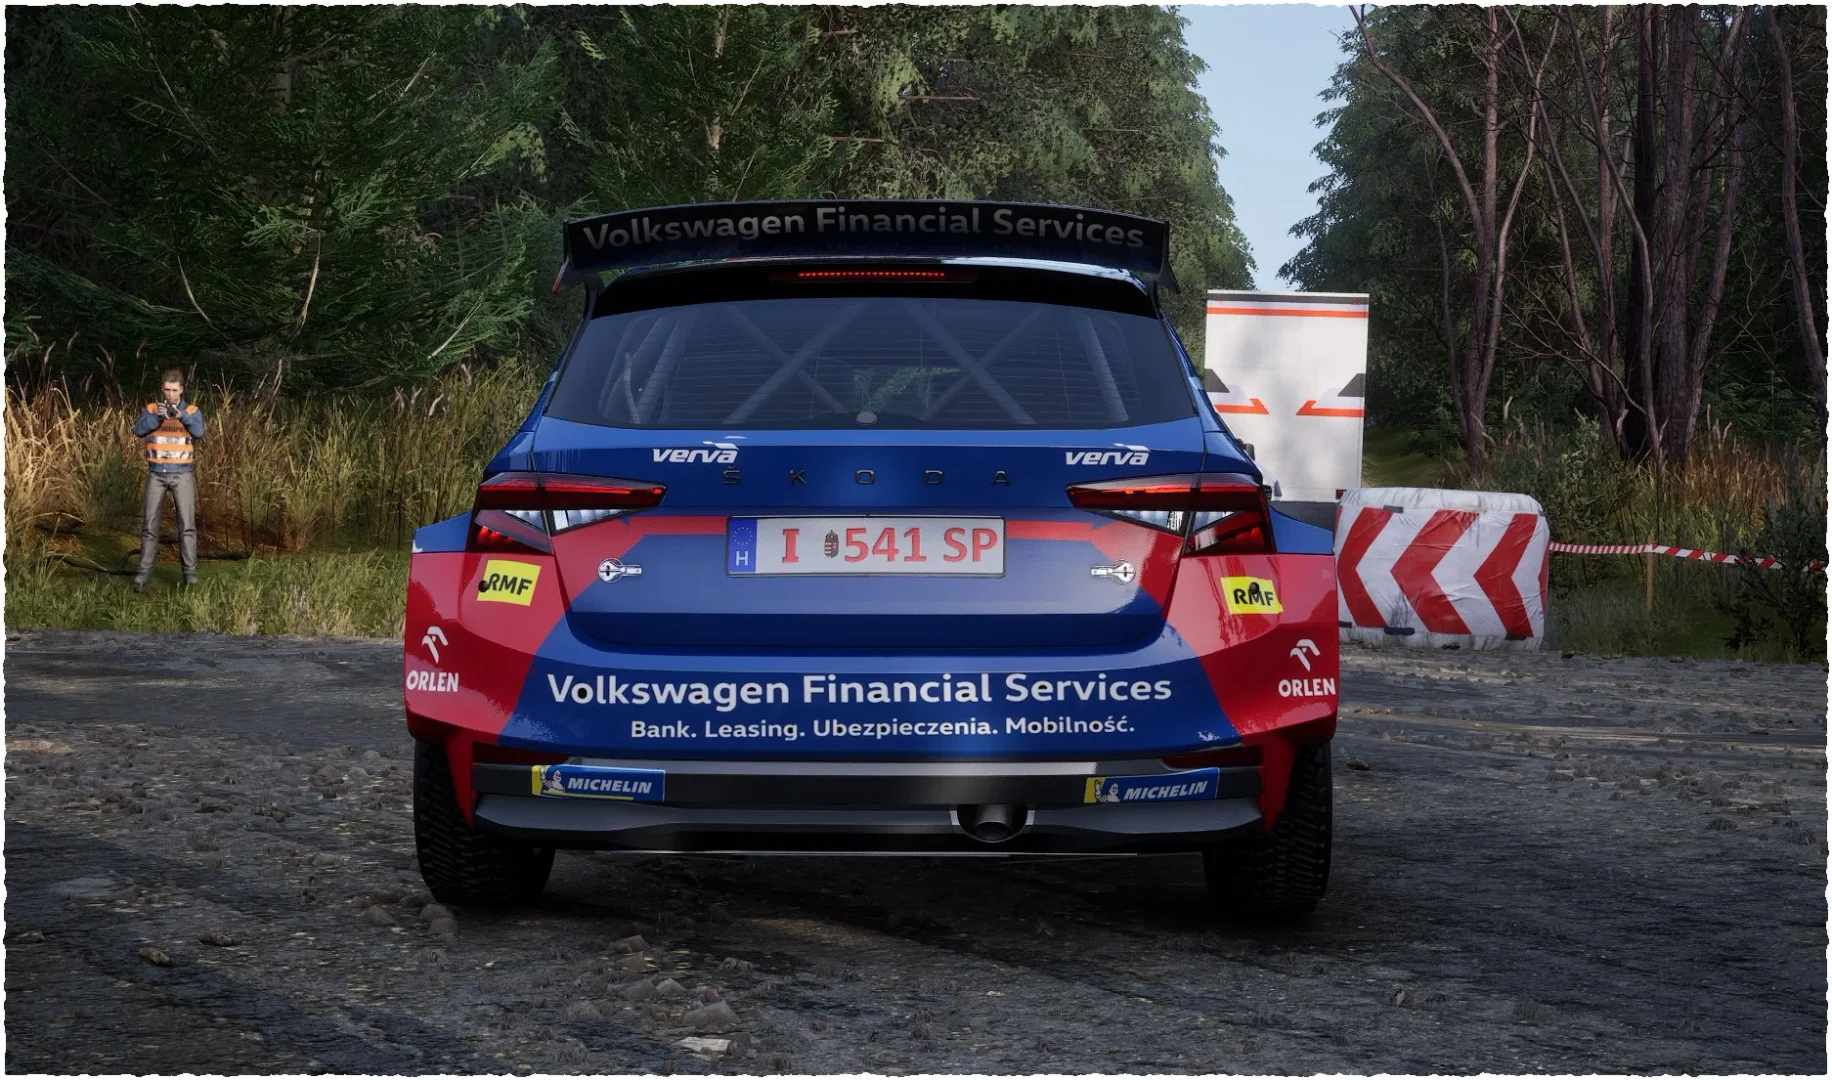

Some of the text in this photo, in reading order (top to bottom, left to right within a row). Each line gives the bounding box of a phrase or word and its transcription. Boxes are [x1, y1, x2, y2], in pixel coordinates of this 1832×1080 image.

[583, 206, 1144, 250] Volkswagen Financial Services
[653, 448, 738, 464] verva
[1066, 450, 1150, 465] verva
[844, 527, 926, 562] 541
[943, 527, 998, 562] SP
[735, 551, 749, 566] H
[487, 573, 532, 596] RMF
[1233, 588, 1274, 606] RMF
[406, 670, 459, 692] ORLEN
[1278, 678, 1336, 697] ORLEN
[547, 673, 1172, 712] Volkswagen Financial Services
[631, 715, 1134, 741] Bank. Leasing. Ubezpieczenia. Mobilność.
[567, 777, 652, 794] MICHELIN
[1124, 780, 1208, 800] MICHELIN
